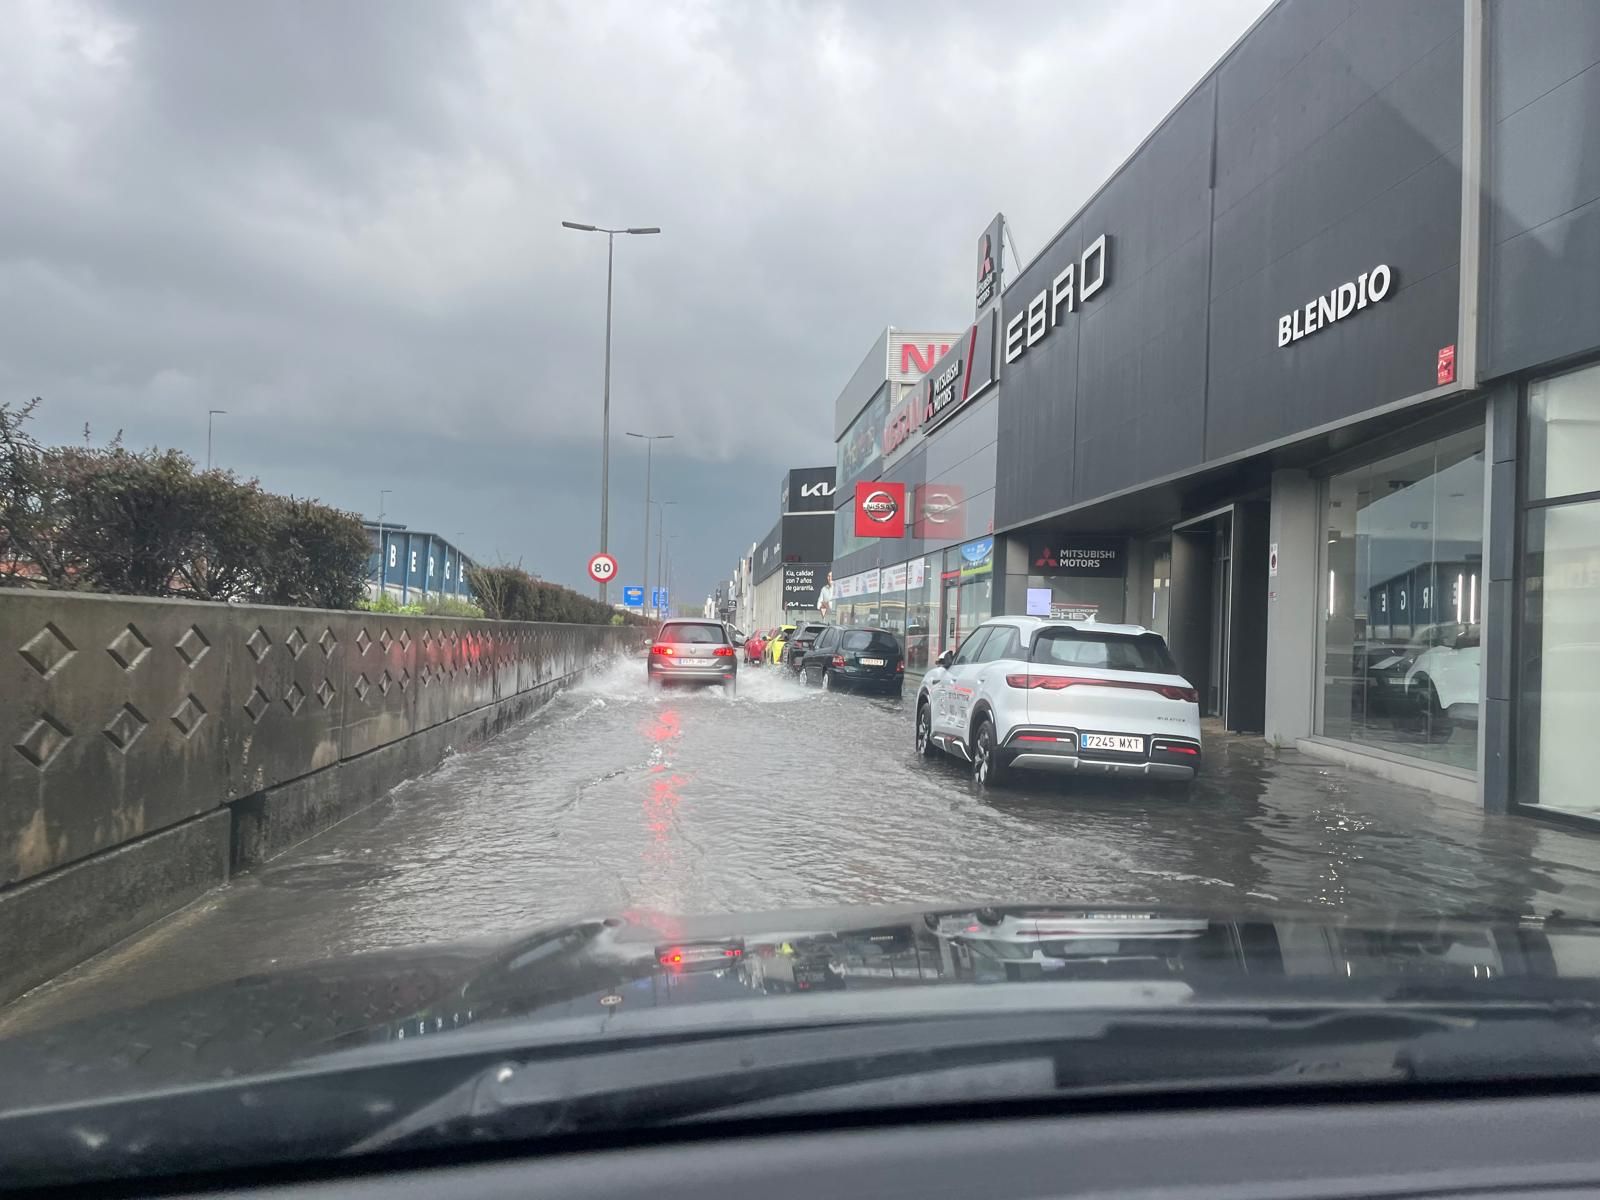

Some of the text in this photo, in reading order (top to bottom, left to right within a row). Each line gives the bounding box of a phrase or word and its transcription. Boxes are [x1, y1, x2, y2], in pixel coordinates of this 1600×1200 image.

[1005, 234, 1106, 364] EBRO
[1278, 264, 1392, 348] BLENDIO
[934, 360, 959, 394] MITSUBISHI
[934, 385, 952, 413] MOTORS
[390, 544, 464, 583] BERGE
[594, 563, 611, 573] 80
[1060, 550, 1115, 559] MITSUBISHI
[1060, 559, 1100, 568] MOTORS
[1087, 736, 1142, 751] 7245 MXT
